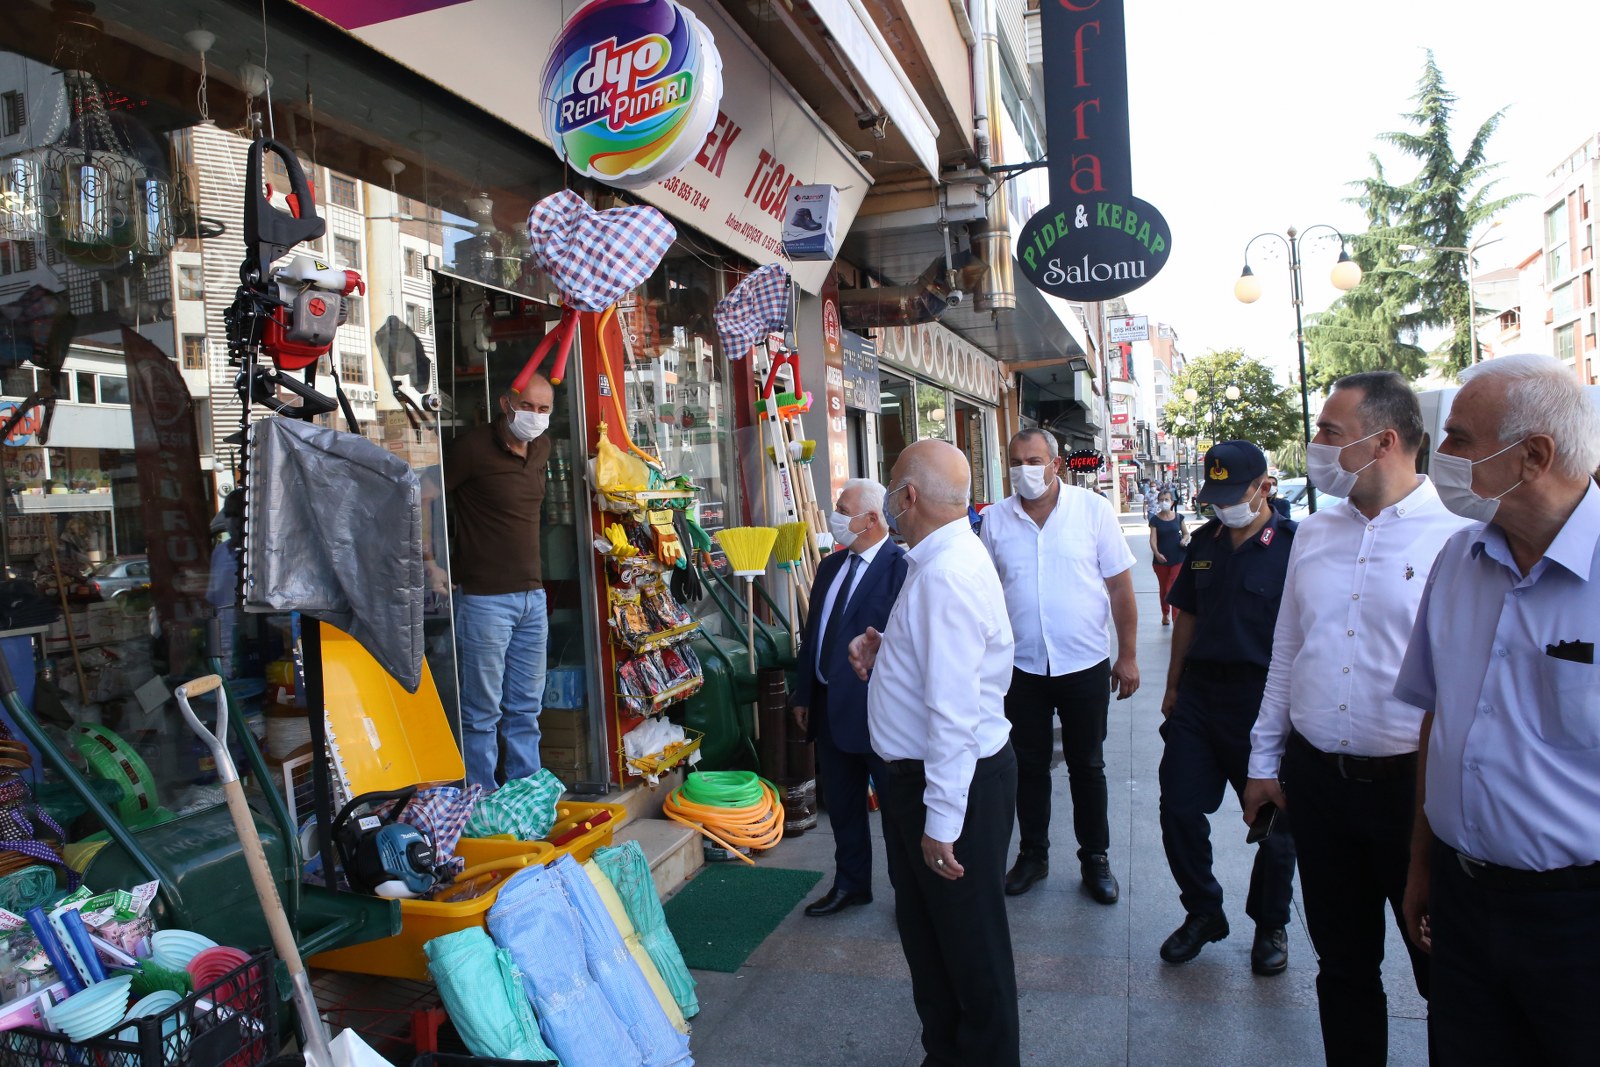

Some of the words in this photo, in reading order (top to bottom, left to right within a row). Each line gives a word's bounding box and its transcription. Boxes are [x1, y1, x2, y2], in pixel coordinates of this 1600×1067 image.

[577, 41, 663, 95] dyo
[559, 88, 614, 128] RENK
[613, 77, 687, 124] PINARI
[1057, 0, 1108, 195] fra
[677, 182, 692, 202] 855
[692, 192, 702, 208] 78
[699, 198, 711, 212] 44
[725, 212, 741, 234] Adnan
[1023, 212, 1069, 271] PİDE
[1075, 204, 1088, 229] &
[1096, 202, 1166, 257] KEBAP
[1043, 254, 1147, 286] Salonu
